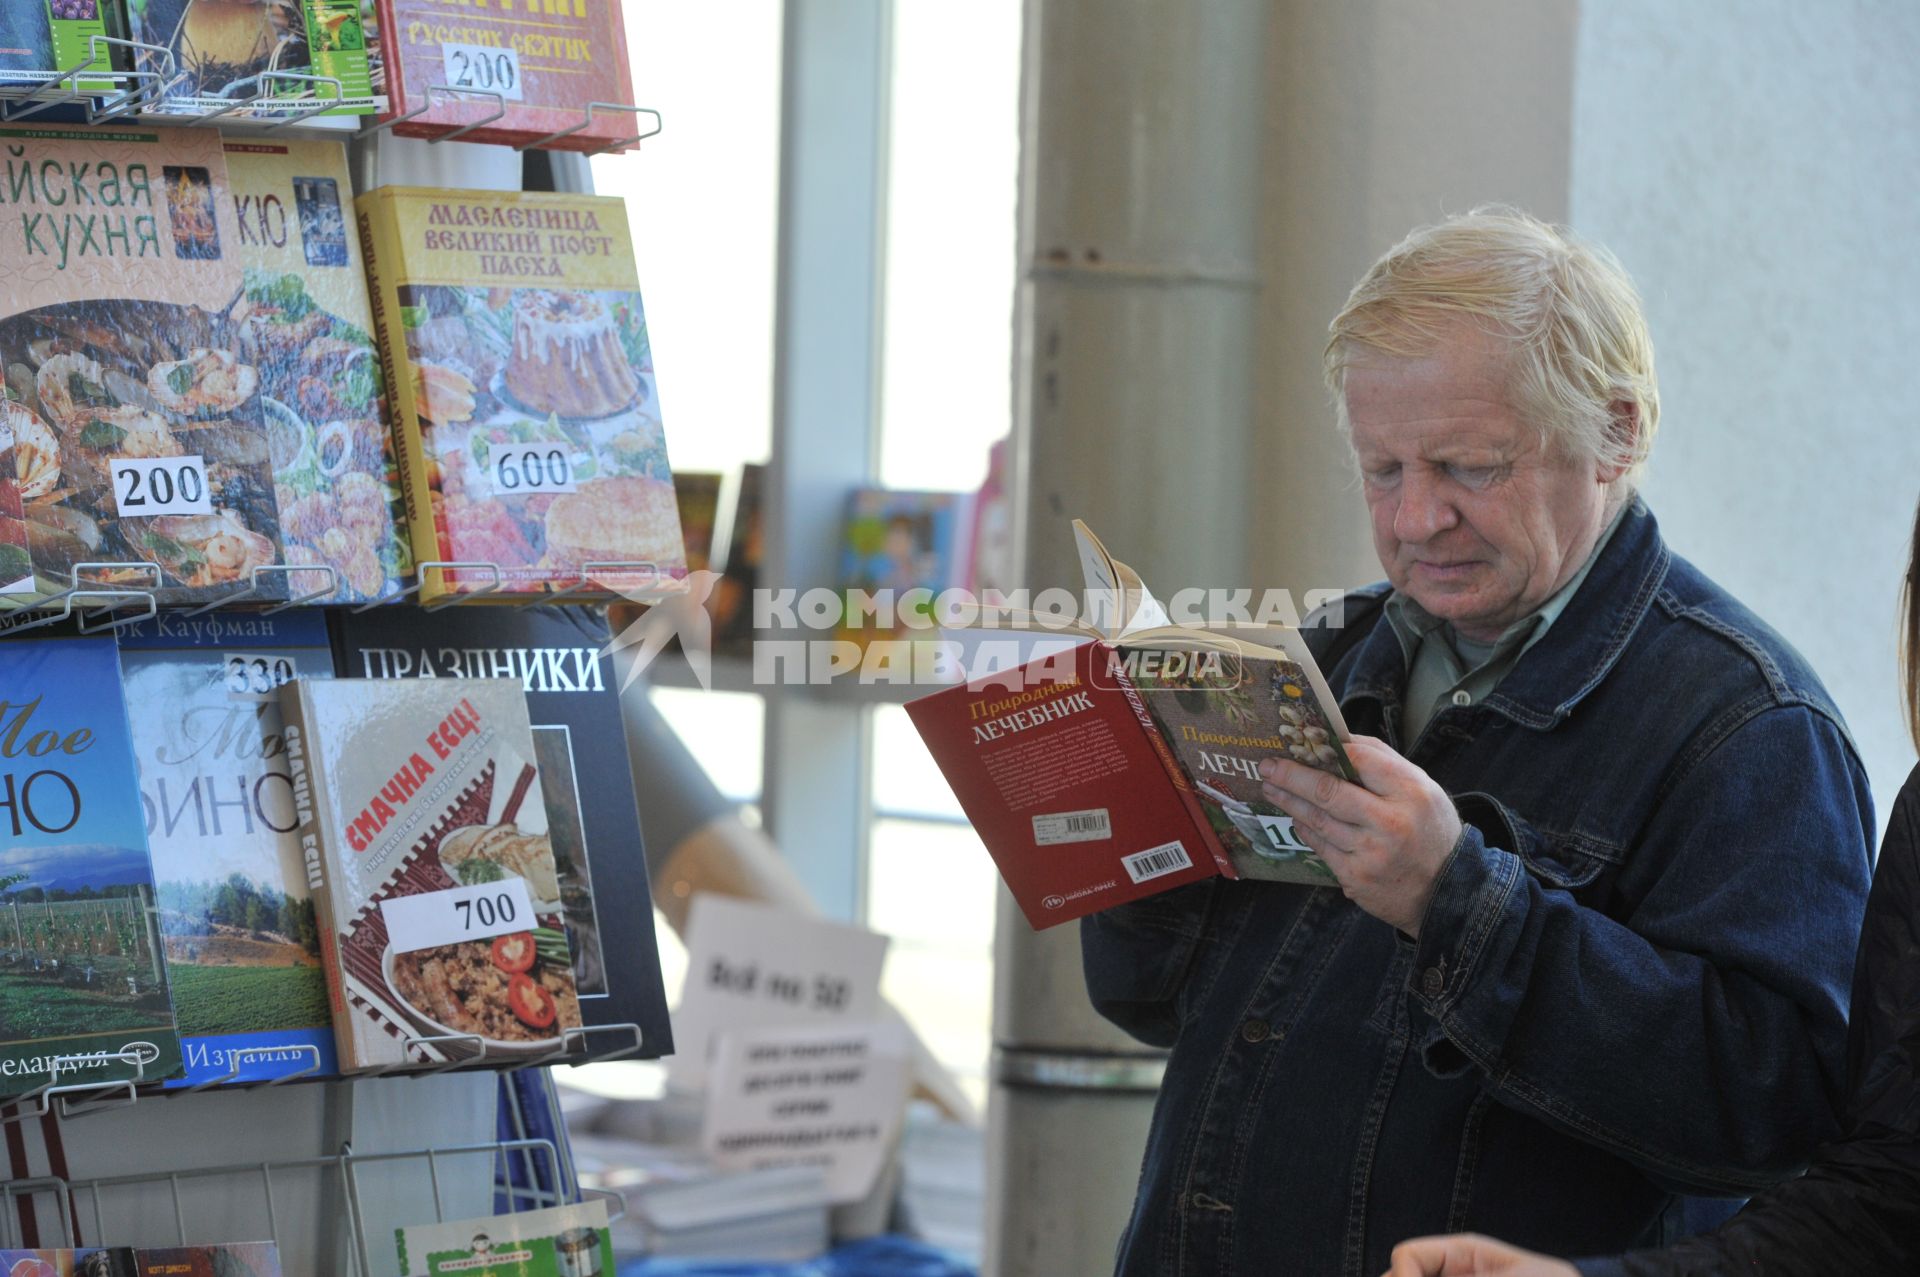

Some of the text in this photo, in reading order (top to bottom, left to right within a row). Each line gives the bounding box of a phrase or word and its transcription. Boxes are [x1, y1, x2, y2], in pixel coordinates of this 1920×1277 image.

[510, 33, 592, 64] СВЯТЫХ
[452, 50, 515, 91] 200
[0, 145, 153, 207] йская
[428, 204, 600, 233] МАСЛЕНИЦА
[22, 212, 161, 270] кухня
[424, 228, 613, 256] ВЕЛИКИЙ ПОСТ
[480, 255, 565, 278] ПАСХА
[117, 465, 203, 507] 200
[497, 448, 570, 490] 600
[157, 613, 276, 645] Кауфман
[228, 657, 293, 694] 330
[359, 648, 606, 692] ПРАЗДНИКИ
[969, 671, 1083, 720] Природный
[972, 690, 1096, 745] ЛЕЧЕБНИК
[1182, 723, 1285, 750] Природный
[344, 752, 435, 853] СМАЧНА
[454, 893, 516, 931] 700
[0, 1049, 110, 1076] еландия
[186, 1042, 304, 1074] Израиль
